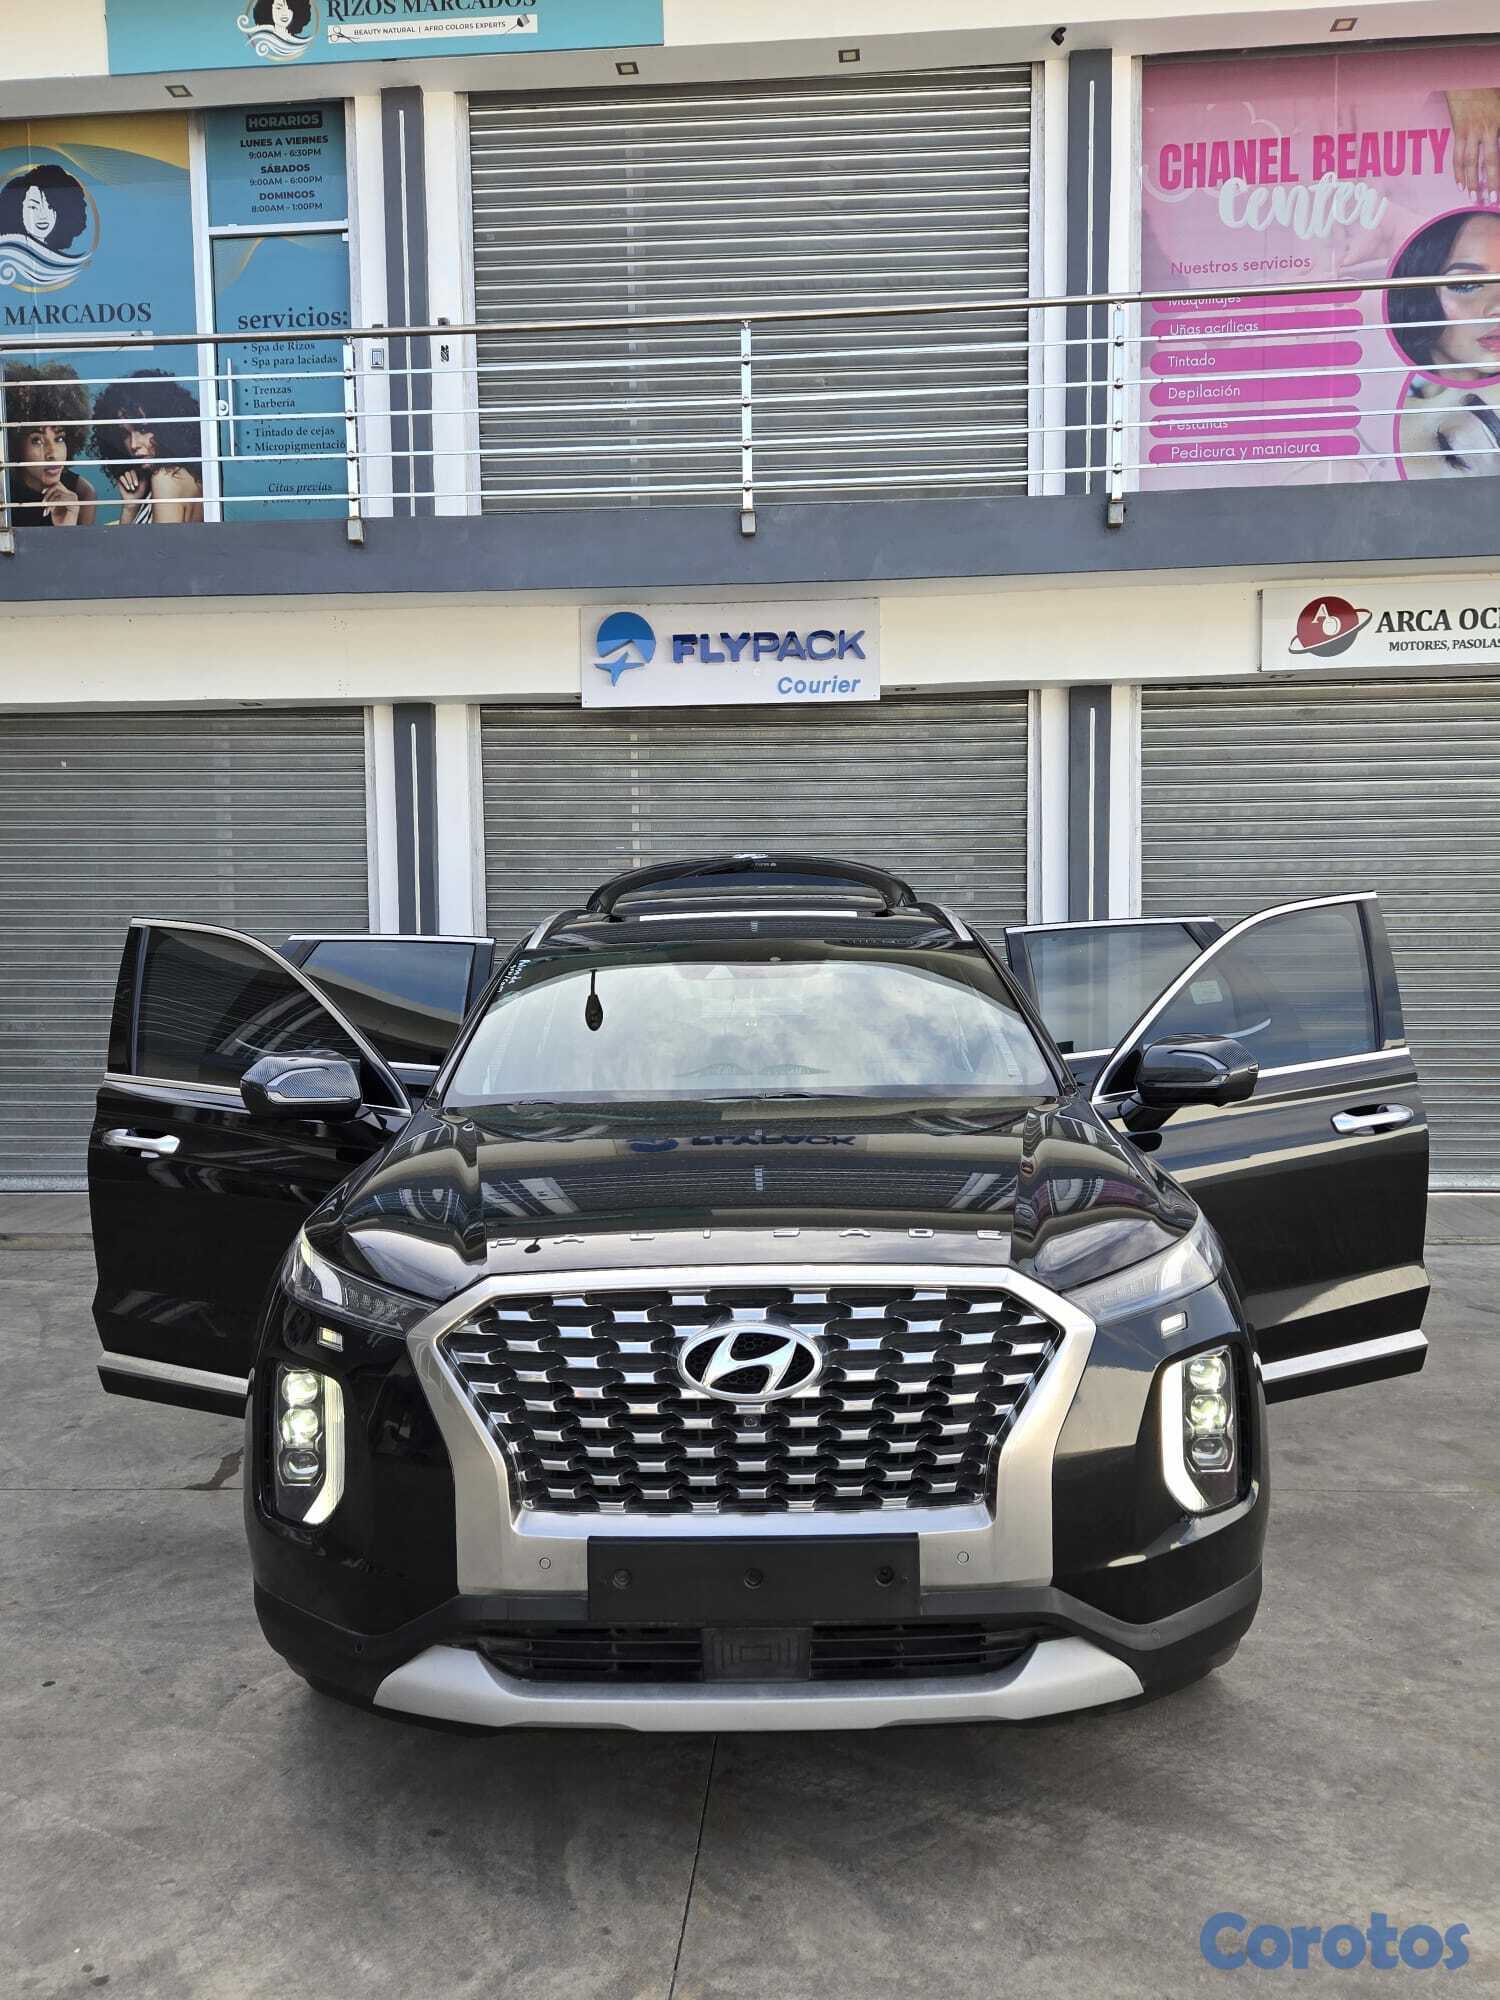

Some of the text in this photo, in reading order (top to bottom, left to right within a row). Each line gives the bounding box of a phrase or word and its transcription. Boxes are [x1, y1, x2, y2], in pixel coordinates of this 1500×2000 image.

[327, 0, 397, 21] RIZOS
[445, 23, 474, 31] COLORS
[475, 21, 506, 29] EXPERTS
[248, 114, 320, 129] HORARIOS
[240, 135, 329, 148] LUNES A VIERNES
[1159, 128, 1450, 190] CHANEL BEAUTY
[260, 163, 311, 174] SÁBADOS
[1171, 256, 1311, 275] Nuestros servicios
[4, 302, 152, 326] MARCADOS
[237, 306, 349, 330] servicios:
[1170, 319, 1259, 336] Uñas acrílicas
[251, 340, 316, 354] Spa de Rizos
[251, 354, 339, 369] Spa para laciadas
[1168, 352, 1216, 368] Tintado
[253, 385, 292, 395] Trenzas
[1168, 384, 1241, 402] Depilación
[255, 425, 335, 438] Tintado de cejas
[255, 440, 346, 453] Micropigmentació
[1171, 442, 1321, 461] Pedicura y manicura
[1375, 606, 1500, 633] ARCA OC
[672, 629, 866, 664] FLYPACK
[1389, 639, 1450, 651] MOTORES,
[777, 675, 861, 695] Courier
